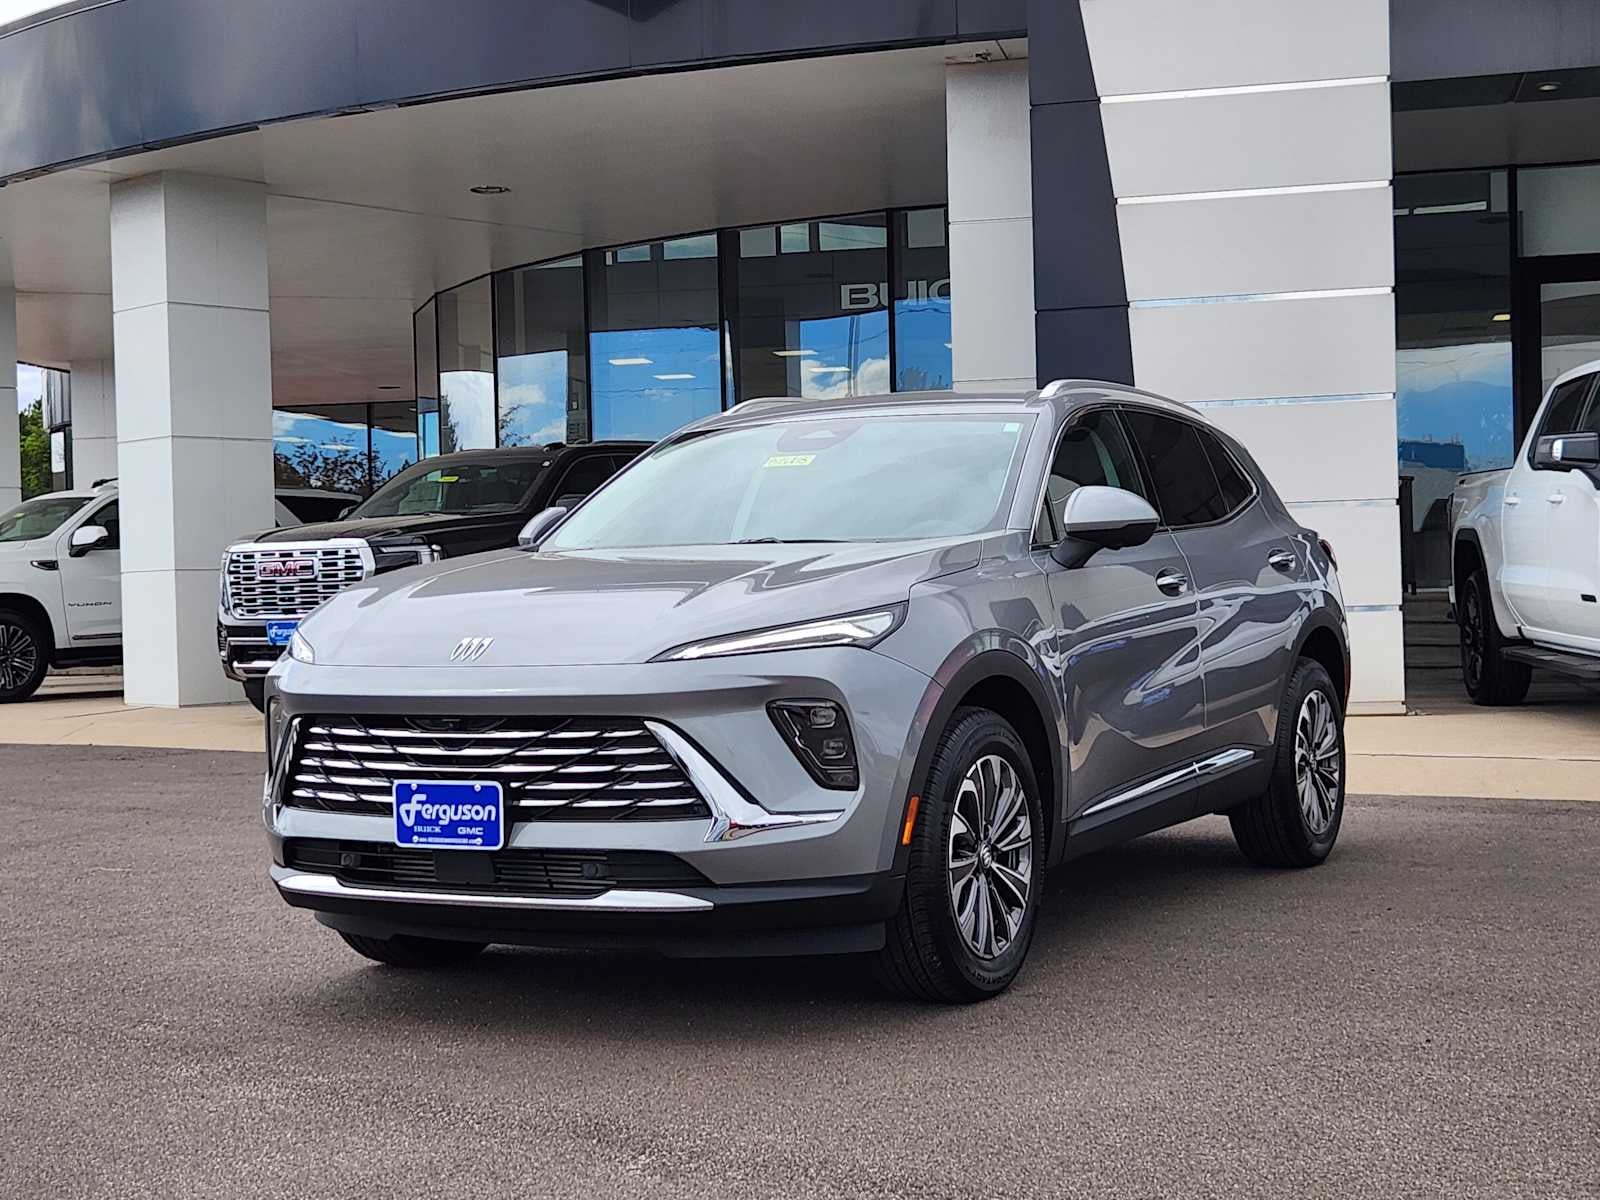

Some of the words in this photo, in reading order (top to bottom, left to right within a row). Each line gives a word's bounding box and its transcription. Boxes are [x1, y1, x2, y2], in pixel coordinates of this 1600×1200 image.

[841, 279, 950, 309] BUIC
[260, 561, 313, 577] GMC
[399, 793, 497, 827] Ferguson
[413, 825, 442, 833] BUICK
[457, 827, 484, 836] GMC
